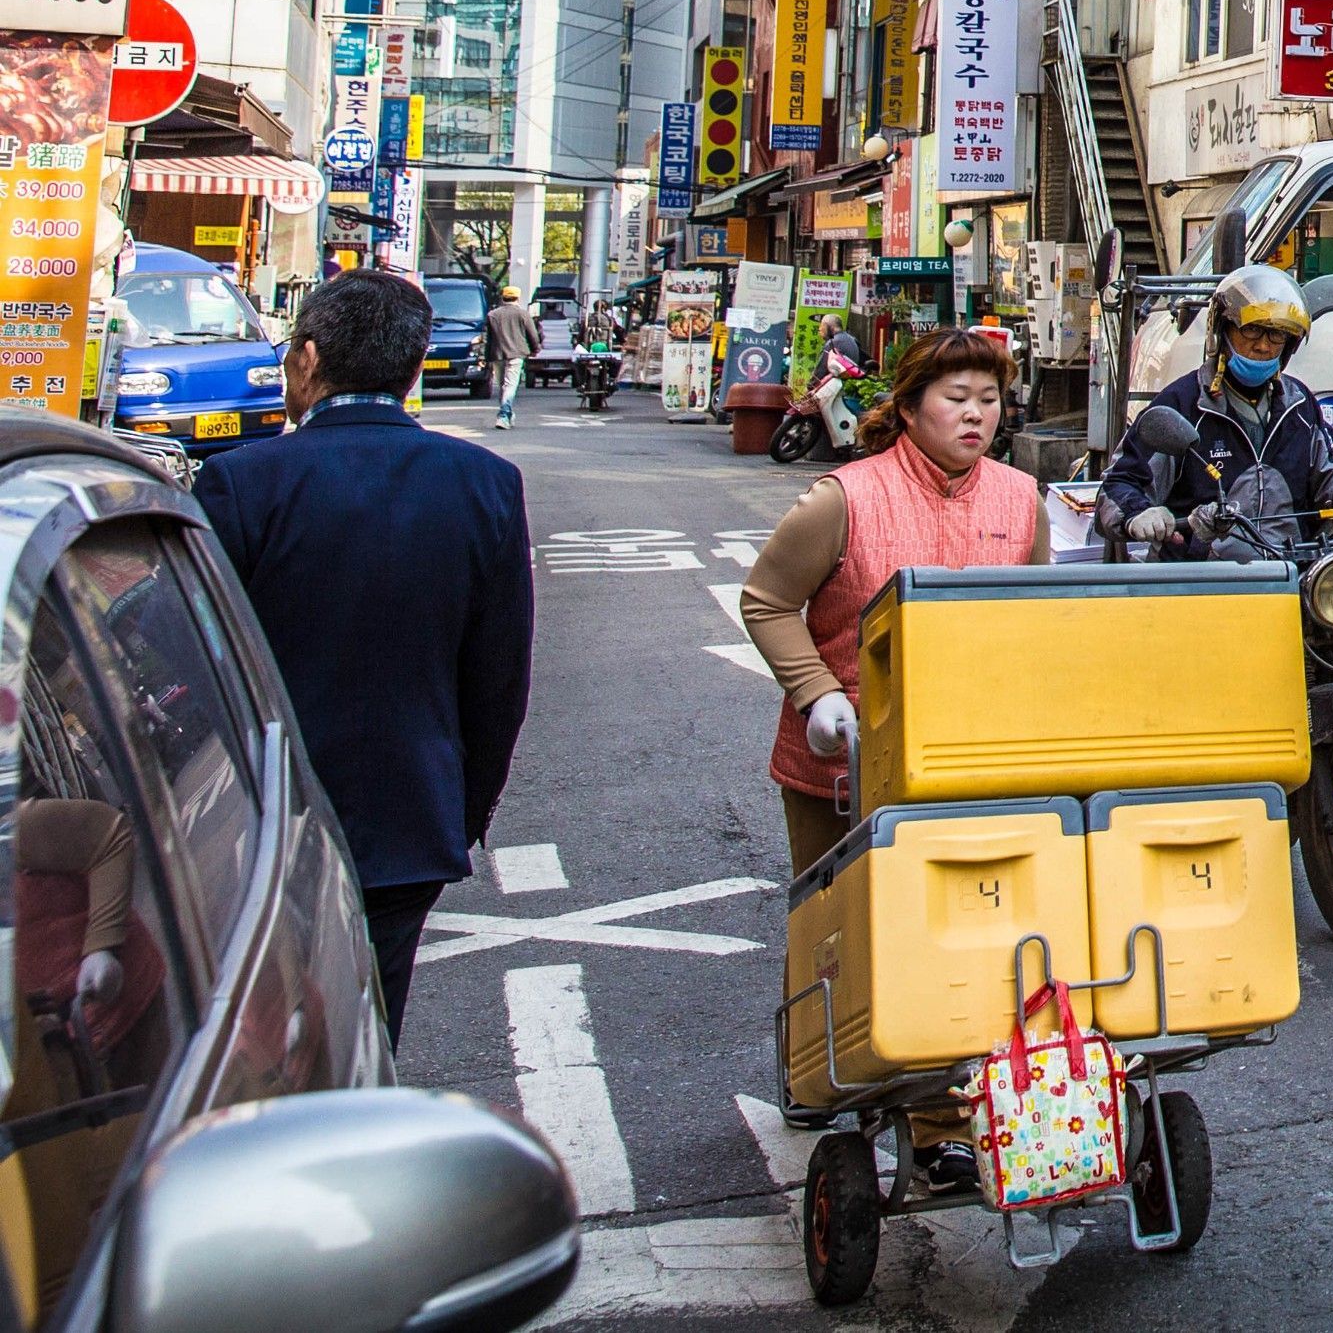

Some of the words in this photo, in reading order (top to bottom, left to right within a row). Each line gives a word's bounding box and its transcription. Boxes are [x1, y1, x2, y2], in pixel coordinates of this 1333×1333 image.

[663, 104, 693, 186] 한국코팅
[953, 146, 1002, 163] 토종닭
[28, 143, 87, 170] 猪蹄
[16, 180, 85, 201] 39,000
[12, 219, 81, 239] 34,000
[8, 258, 77, 277] 28,000
[880, 259, 923, 272] 프리미엄
[927, 260, 950, 271] TEA
